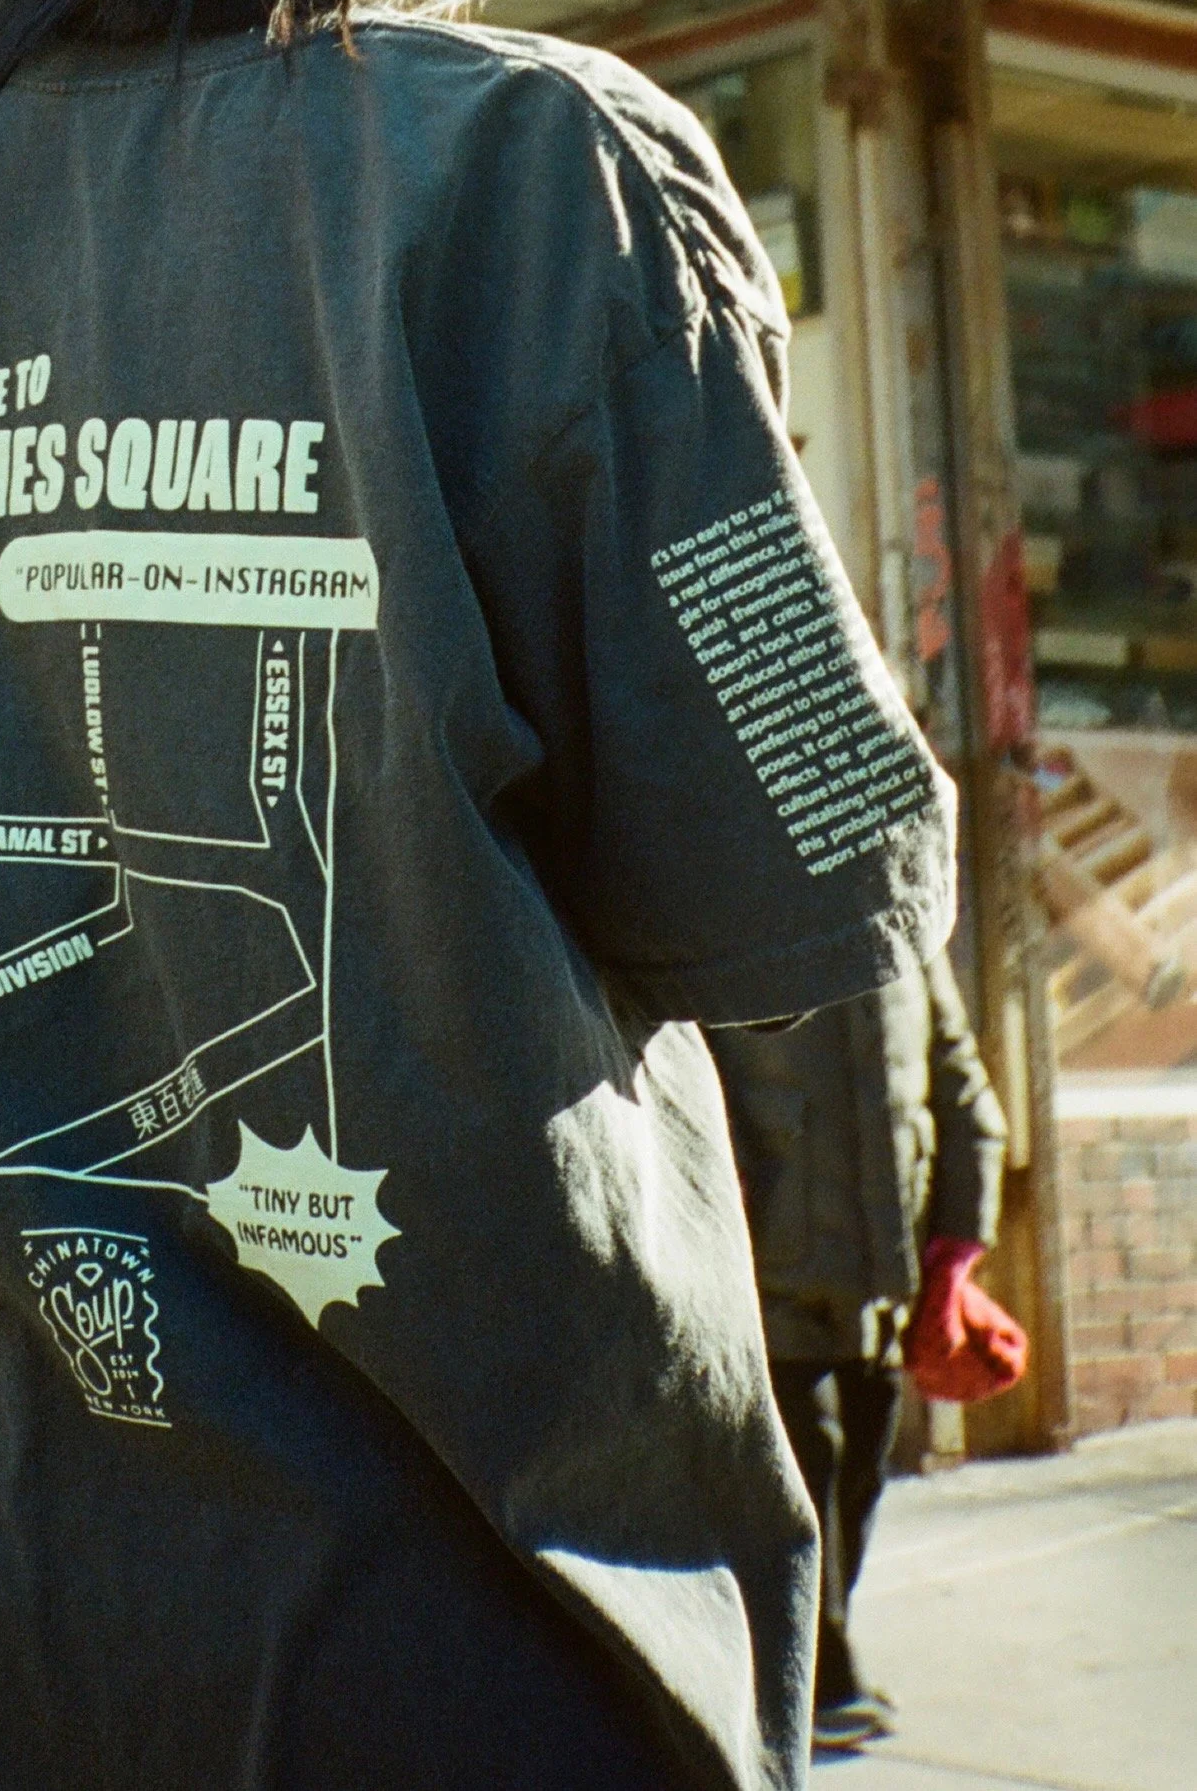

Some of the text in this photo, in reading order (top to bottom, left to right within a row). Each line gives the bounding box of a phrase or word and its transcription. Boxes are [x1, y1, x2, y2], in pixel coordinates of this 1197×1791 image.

[15, 353, 52, 411] TO
[75, 417, 325, 515] SQUARE
[669, 537, 696, 556] too
[696, 519, 729, 543] early
[729, 510, 748, 525] to
[748, 499, 772, 517] say
[657, 561, 694, 587] issue
[693, 544, 729, 567] from
[728, 529, 757, 550] this
[668, 595, 679, 607] a
[679, 575, 707, 600] real
[707, 545, 781, 586] difference,
[678, 606, 702, 629] gle
[700, 595, 721, 613] for
[721, 557, 801, 602] recognition
[687, 577, 812, 648] guish themselves,
[738, 617, 768, 642] and
[772, 599, 813, 625] critics
[706, 648, 760, 683] doesn't
[758, 631, 793, 655] look
[716, 656, 786, 705] produced
[786, 639, 826, 666] either
[82, 645, 109, 791] LUDLOW ST
[726, 704, 746, 722] an
[746, 679, 797, 709] visions
[798, 662, 826, 685] and
[736, 704, 794, 741] appears
[793, 697, 810, 711] to
[809, 680, 845, 702] have
[261, 659, 291, 791] ESSEX ST
[745, 718, 819, 763] preferring
[817, 710, 835, 724] to
[816, 725, 851, 749] can't
[766, 765, 820, 797] reflects
[824, 751, 850, 769] the
[777, 786, 828, 816] culture
[827, 778, 844, 793] in
[842, 766, 867, 785] the
[786, 793, 865, 836] revitalizing
[864, 772, 902, 800] shock
[903, 766, 916, 781] or
[60, 828, 93, 855] ST
[796, 836, 825, 856] this
[828, 804, 887, 845] probably
[889, 784, 924, 810] won't
[806, 827, 884, 875] vapors and
[308, 1191, 356, 1221] BUT
[27, 1236, 156, 1289] CHINATOWN
[51, 1278, 135, 1396] Soup
